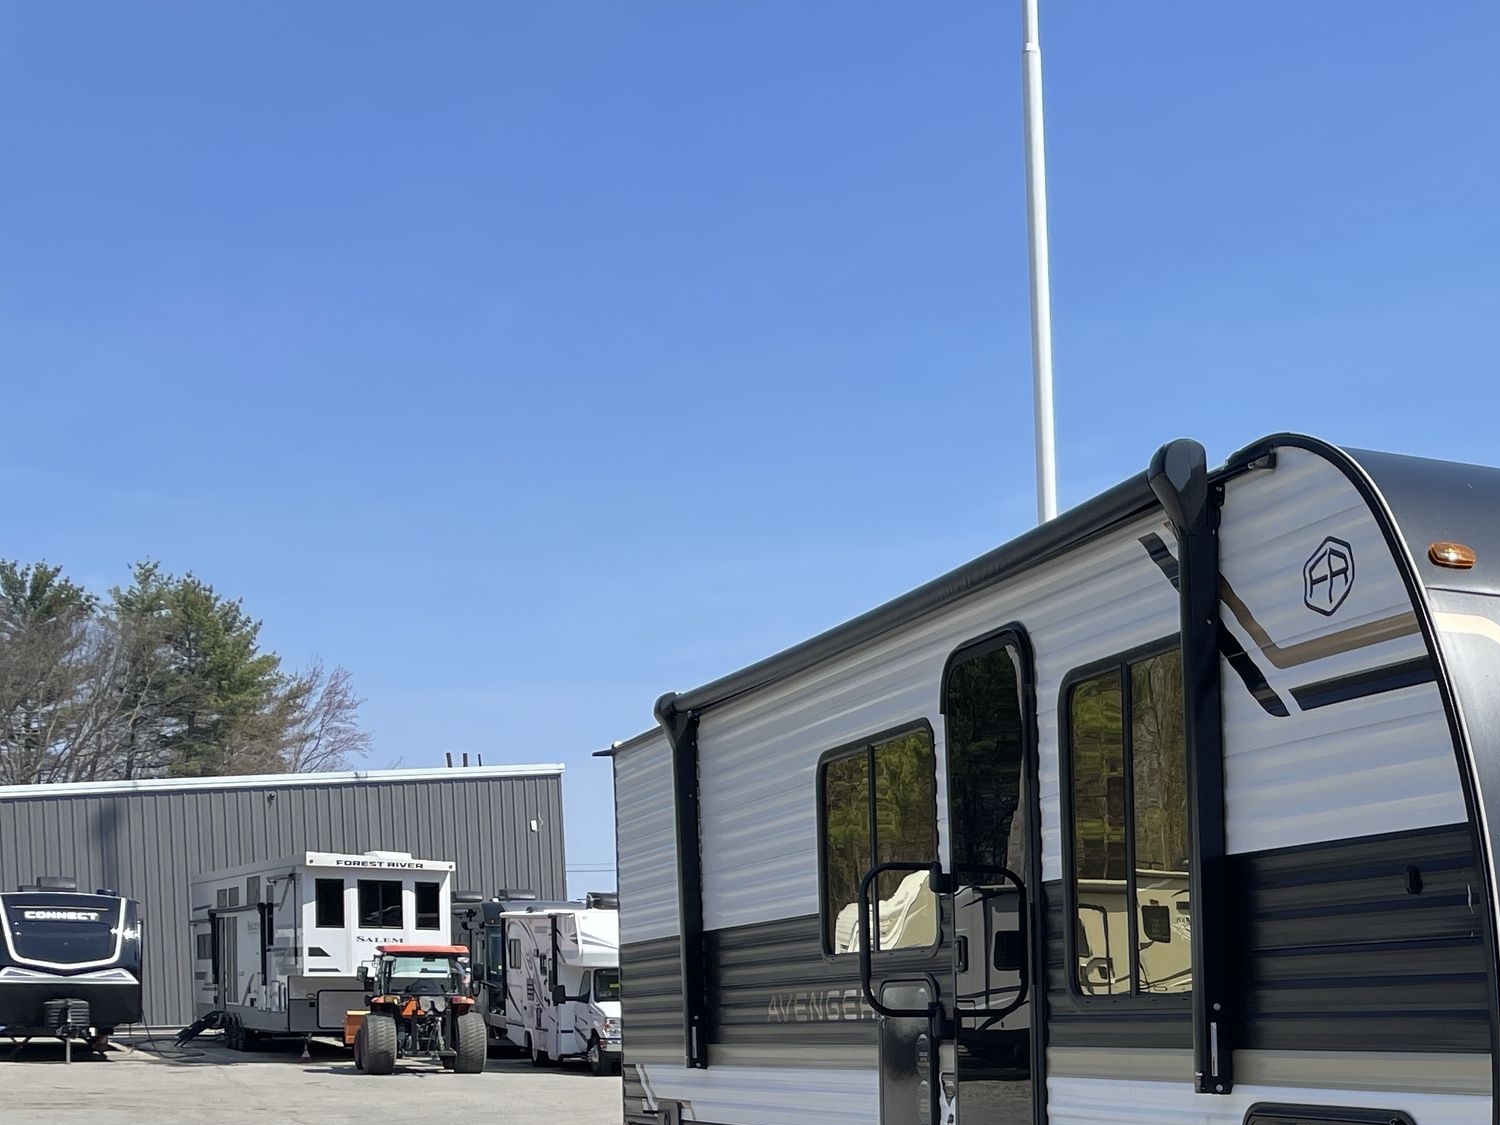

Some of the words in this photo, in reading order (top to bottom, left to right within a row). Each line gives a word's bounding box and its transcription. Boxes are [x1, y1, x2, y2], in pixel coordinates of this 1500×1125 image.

[336, 859, 384, 868] FOREST
[387, 861, 424, 869] RIVER
[24, 911, 99, 921] CONNECT
[356, 935, 404, 944] SALEM
